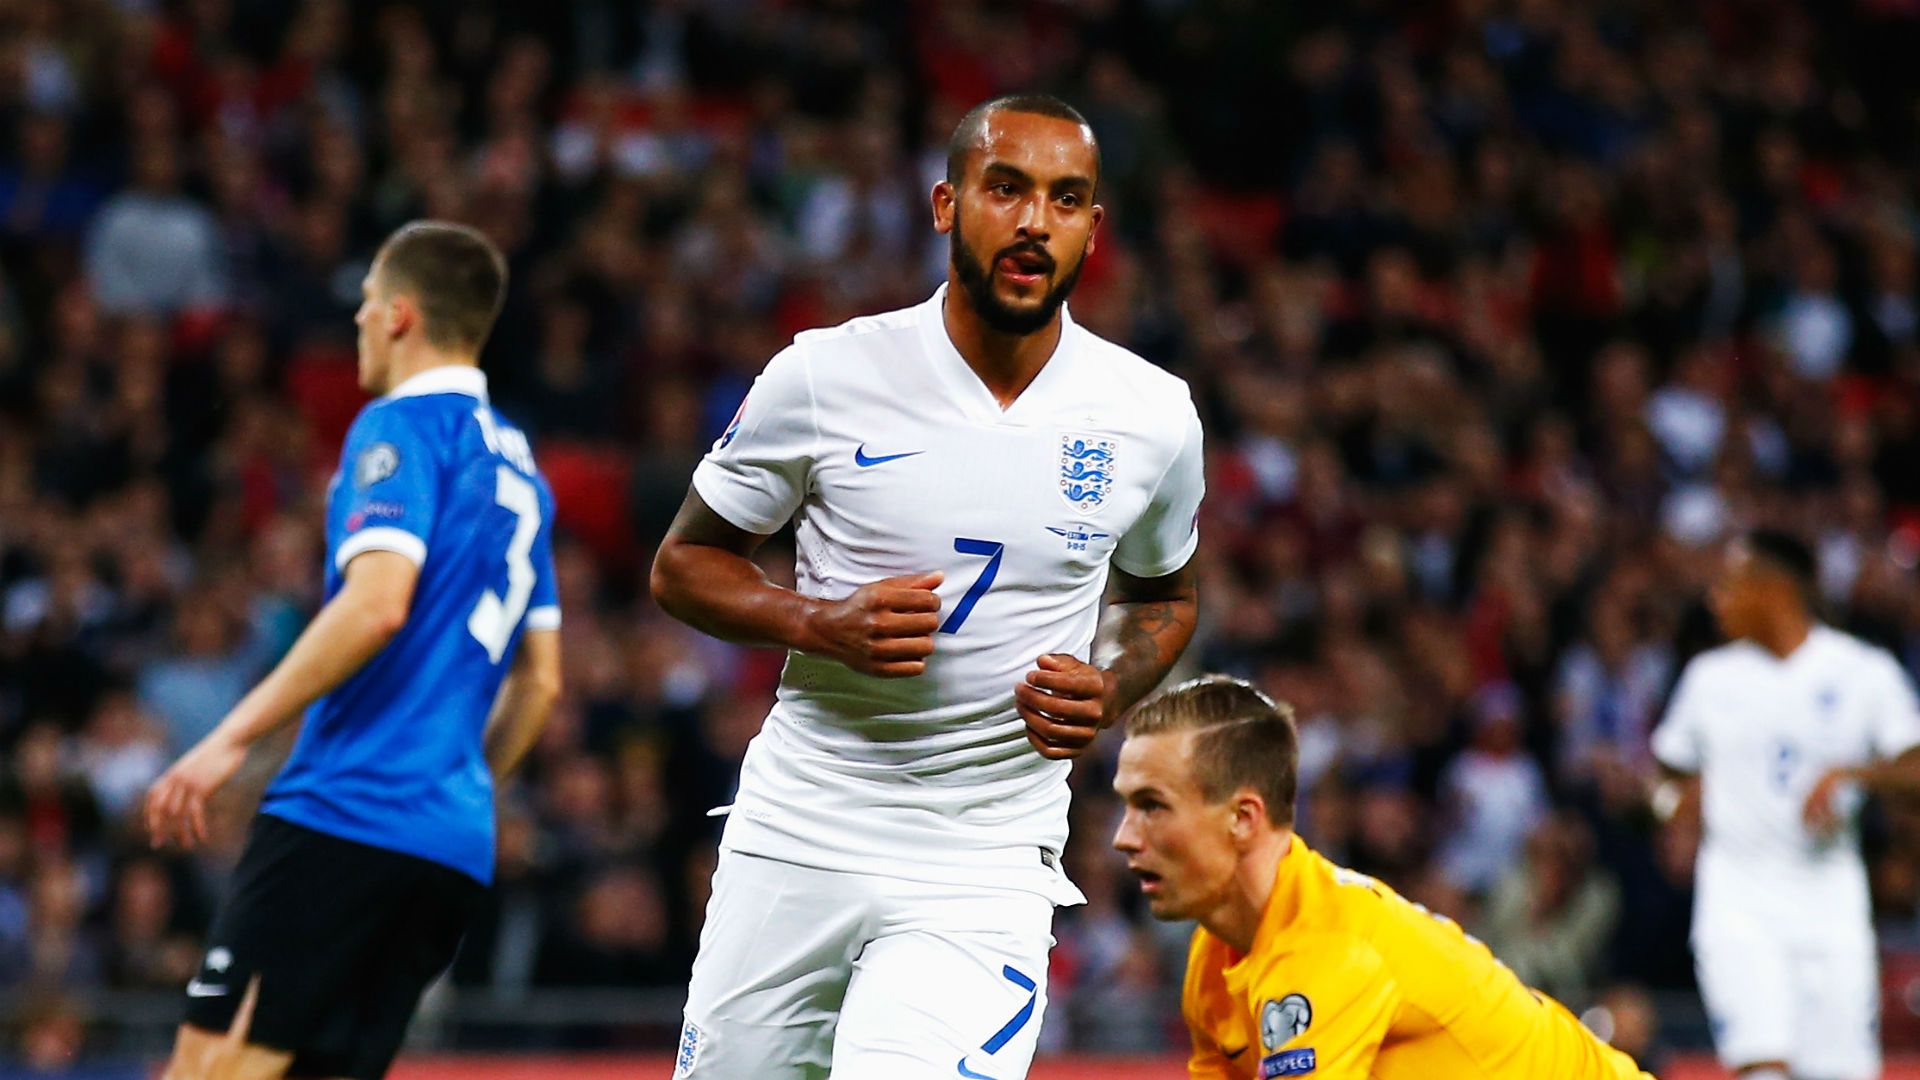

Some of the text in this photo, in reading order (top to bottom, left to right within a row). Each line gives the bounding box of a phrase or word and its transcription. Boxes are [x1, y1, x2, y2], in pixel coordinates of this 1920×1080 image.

[467, 465, 542, 666] 3
[938, 537, 1004, 634] 7
[980, 964, 1038, 1055] 7
